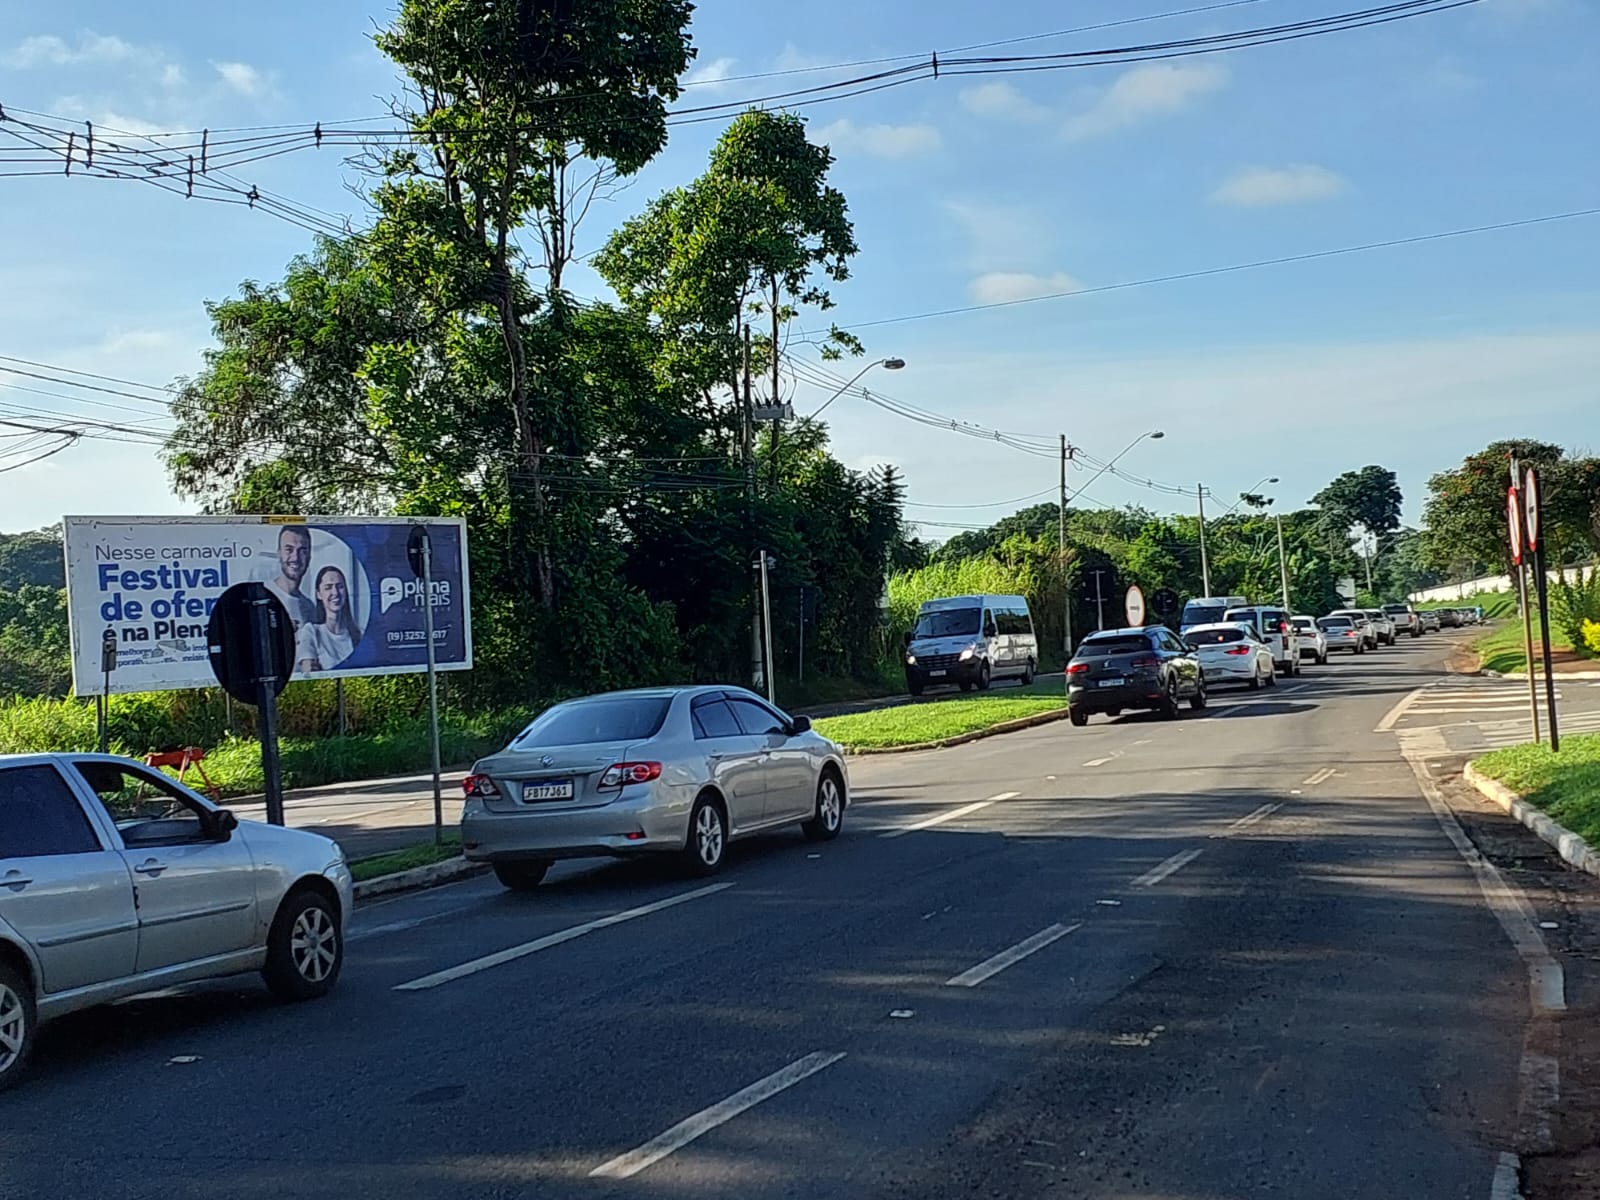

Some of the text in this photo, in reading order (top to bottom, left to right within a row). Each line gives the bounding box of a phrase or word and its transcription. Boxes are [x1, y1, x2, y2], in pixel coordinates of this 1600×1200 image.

[95, 542, 252, 560] Nesse carnaval o
[98, 560, 229, 591] Festival
[100, 592, 143, 621] de
[102, 623, 117, 640] é
[122, 626, 149, 641] na
[404, 630, 447, 640] 3252617
[526, 786, 567, 799] FBT7J61
